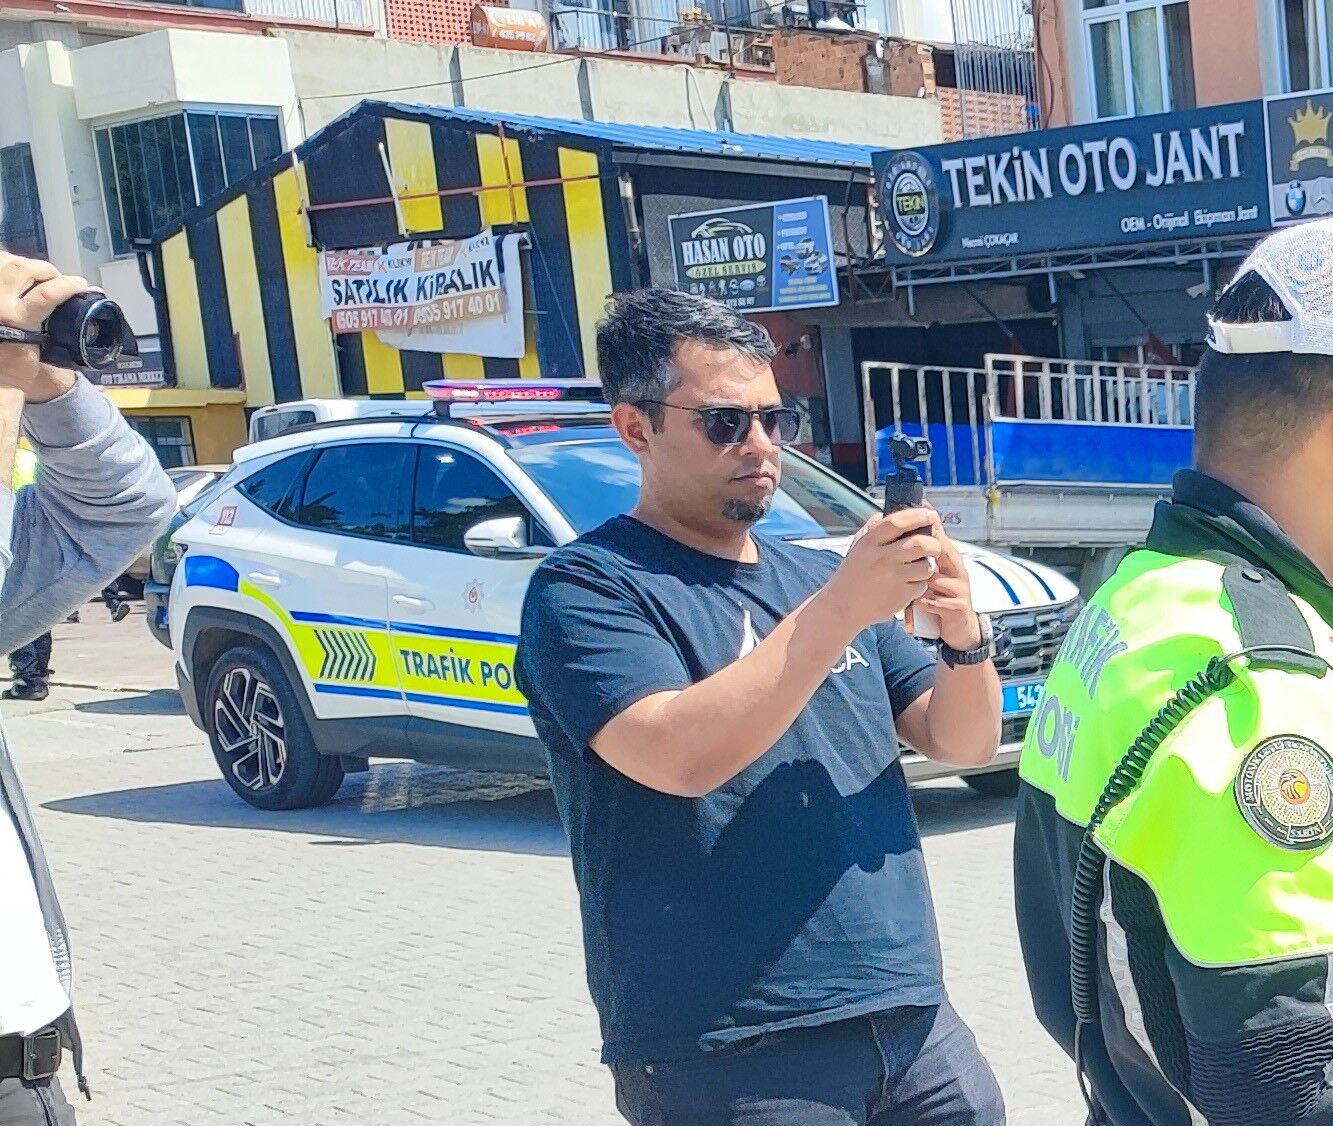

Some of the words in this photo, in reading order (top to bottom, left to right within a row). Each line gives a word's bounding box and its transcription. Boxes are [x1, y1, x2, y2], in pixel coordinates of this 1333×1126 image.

[941, 146, 1053, 208] TEKİN
[1058, 137, 1137, 196] OTO
[1146, 120, 1245, 187] JANT
[681, 236, 731, 266] HASAN
[732, 232, 767, 261] OTO
[400, 647, 475, 685] TRAFİK
